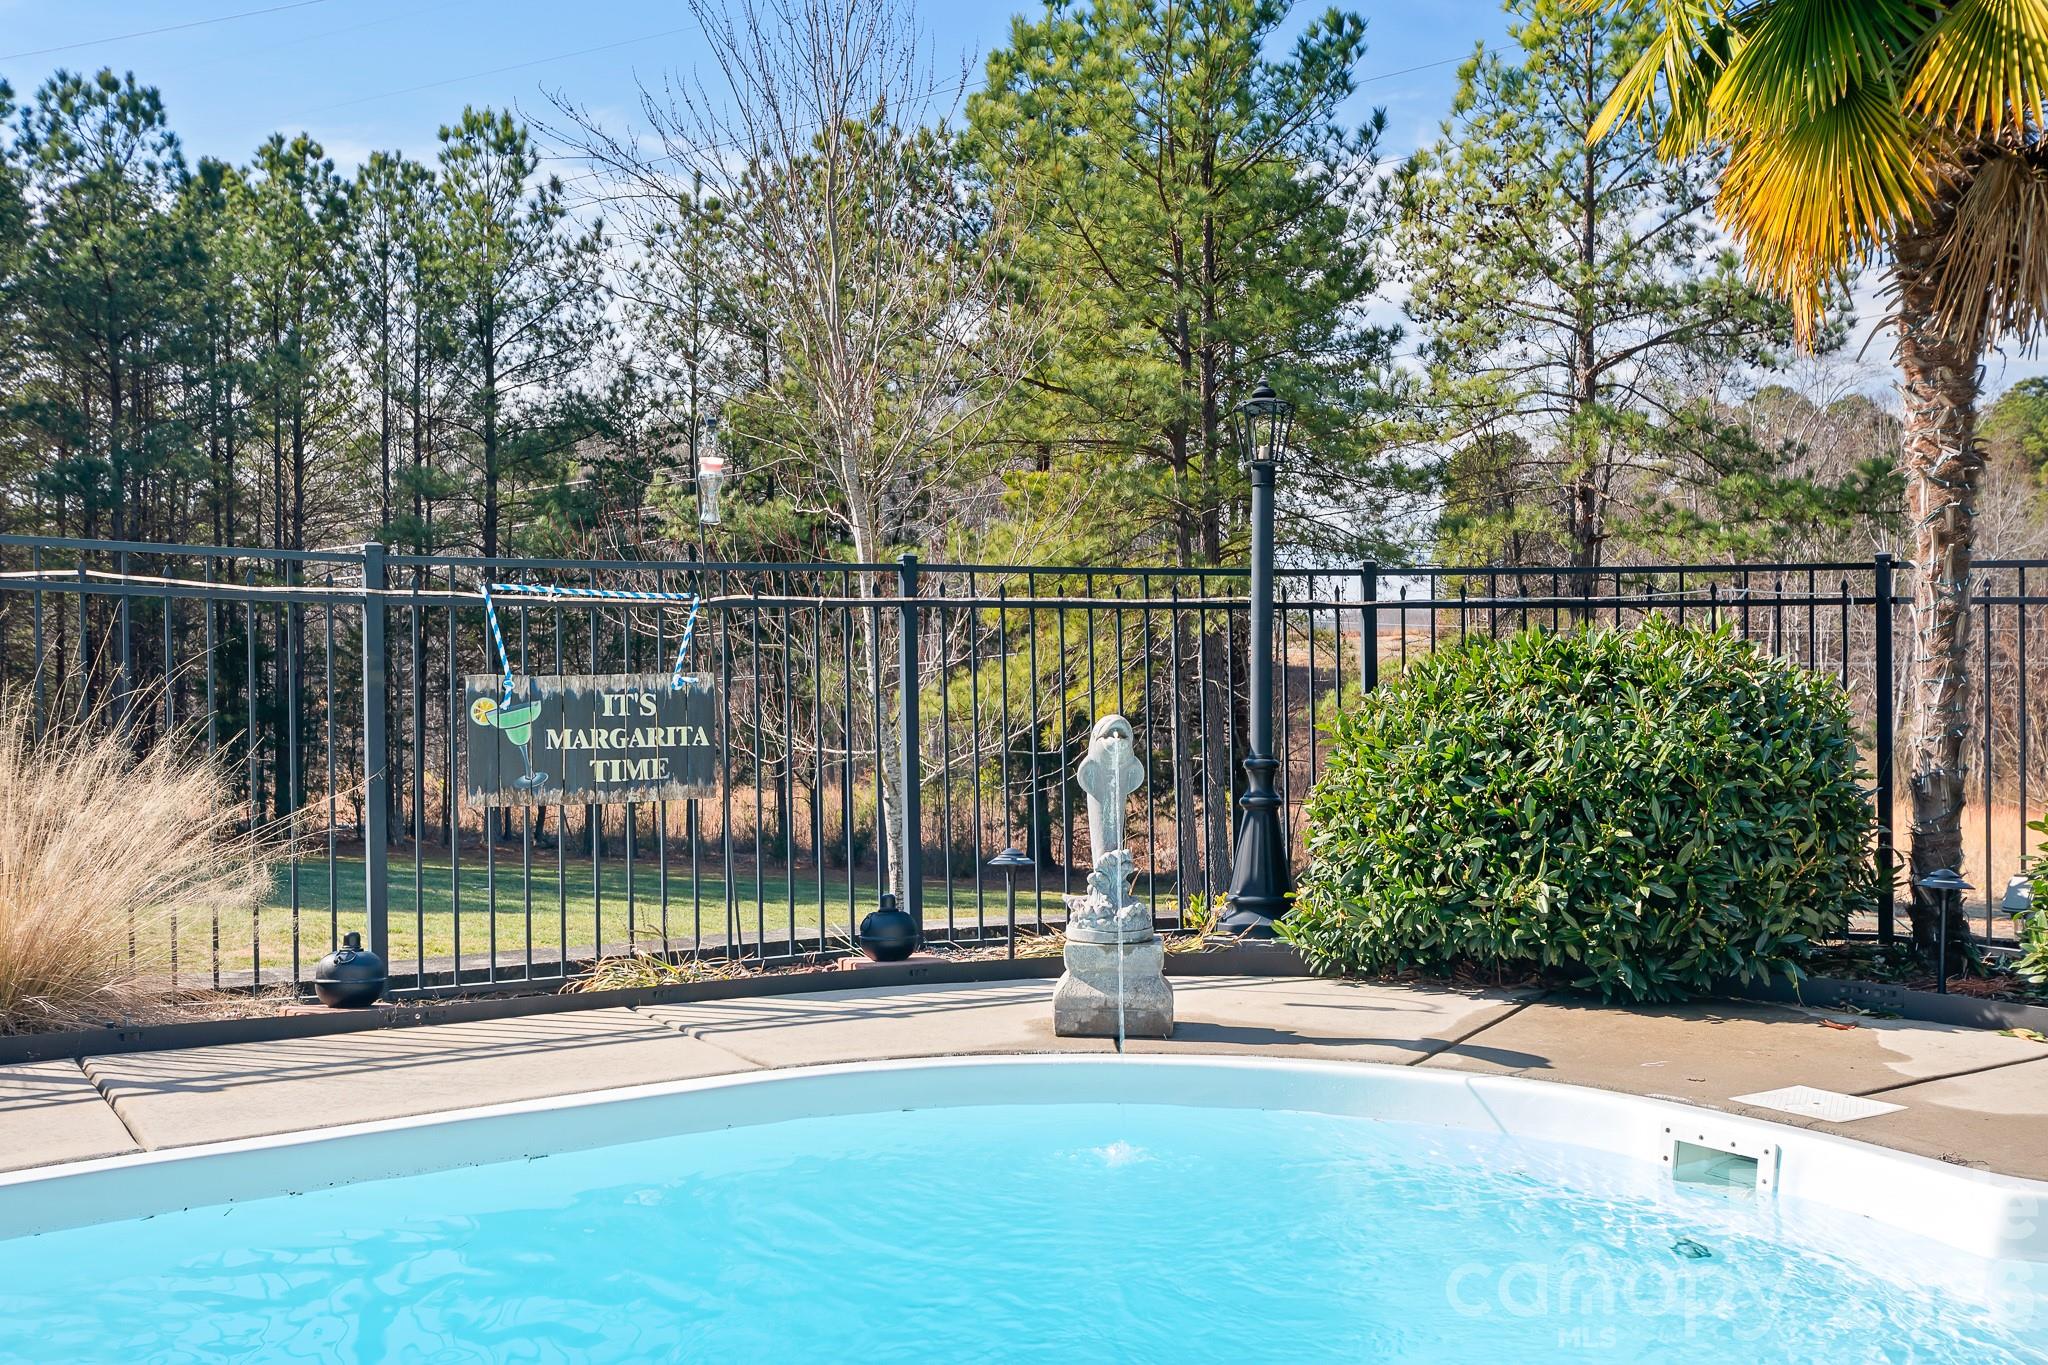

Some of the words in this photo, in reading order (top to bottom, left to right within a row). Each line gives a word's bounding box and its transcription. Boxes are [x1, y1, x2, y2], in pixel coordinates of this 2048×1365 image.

[602, 692, 657, 717] IT'S
[546, 726, 710, 750] MARGARITA
[590, 757, 670, 783] TIME
